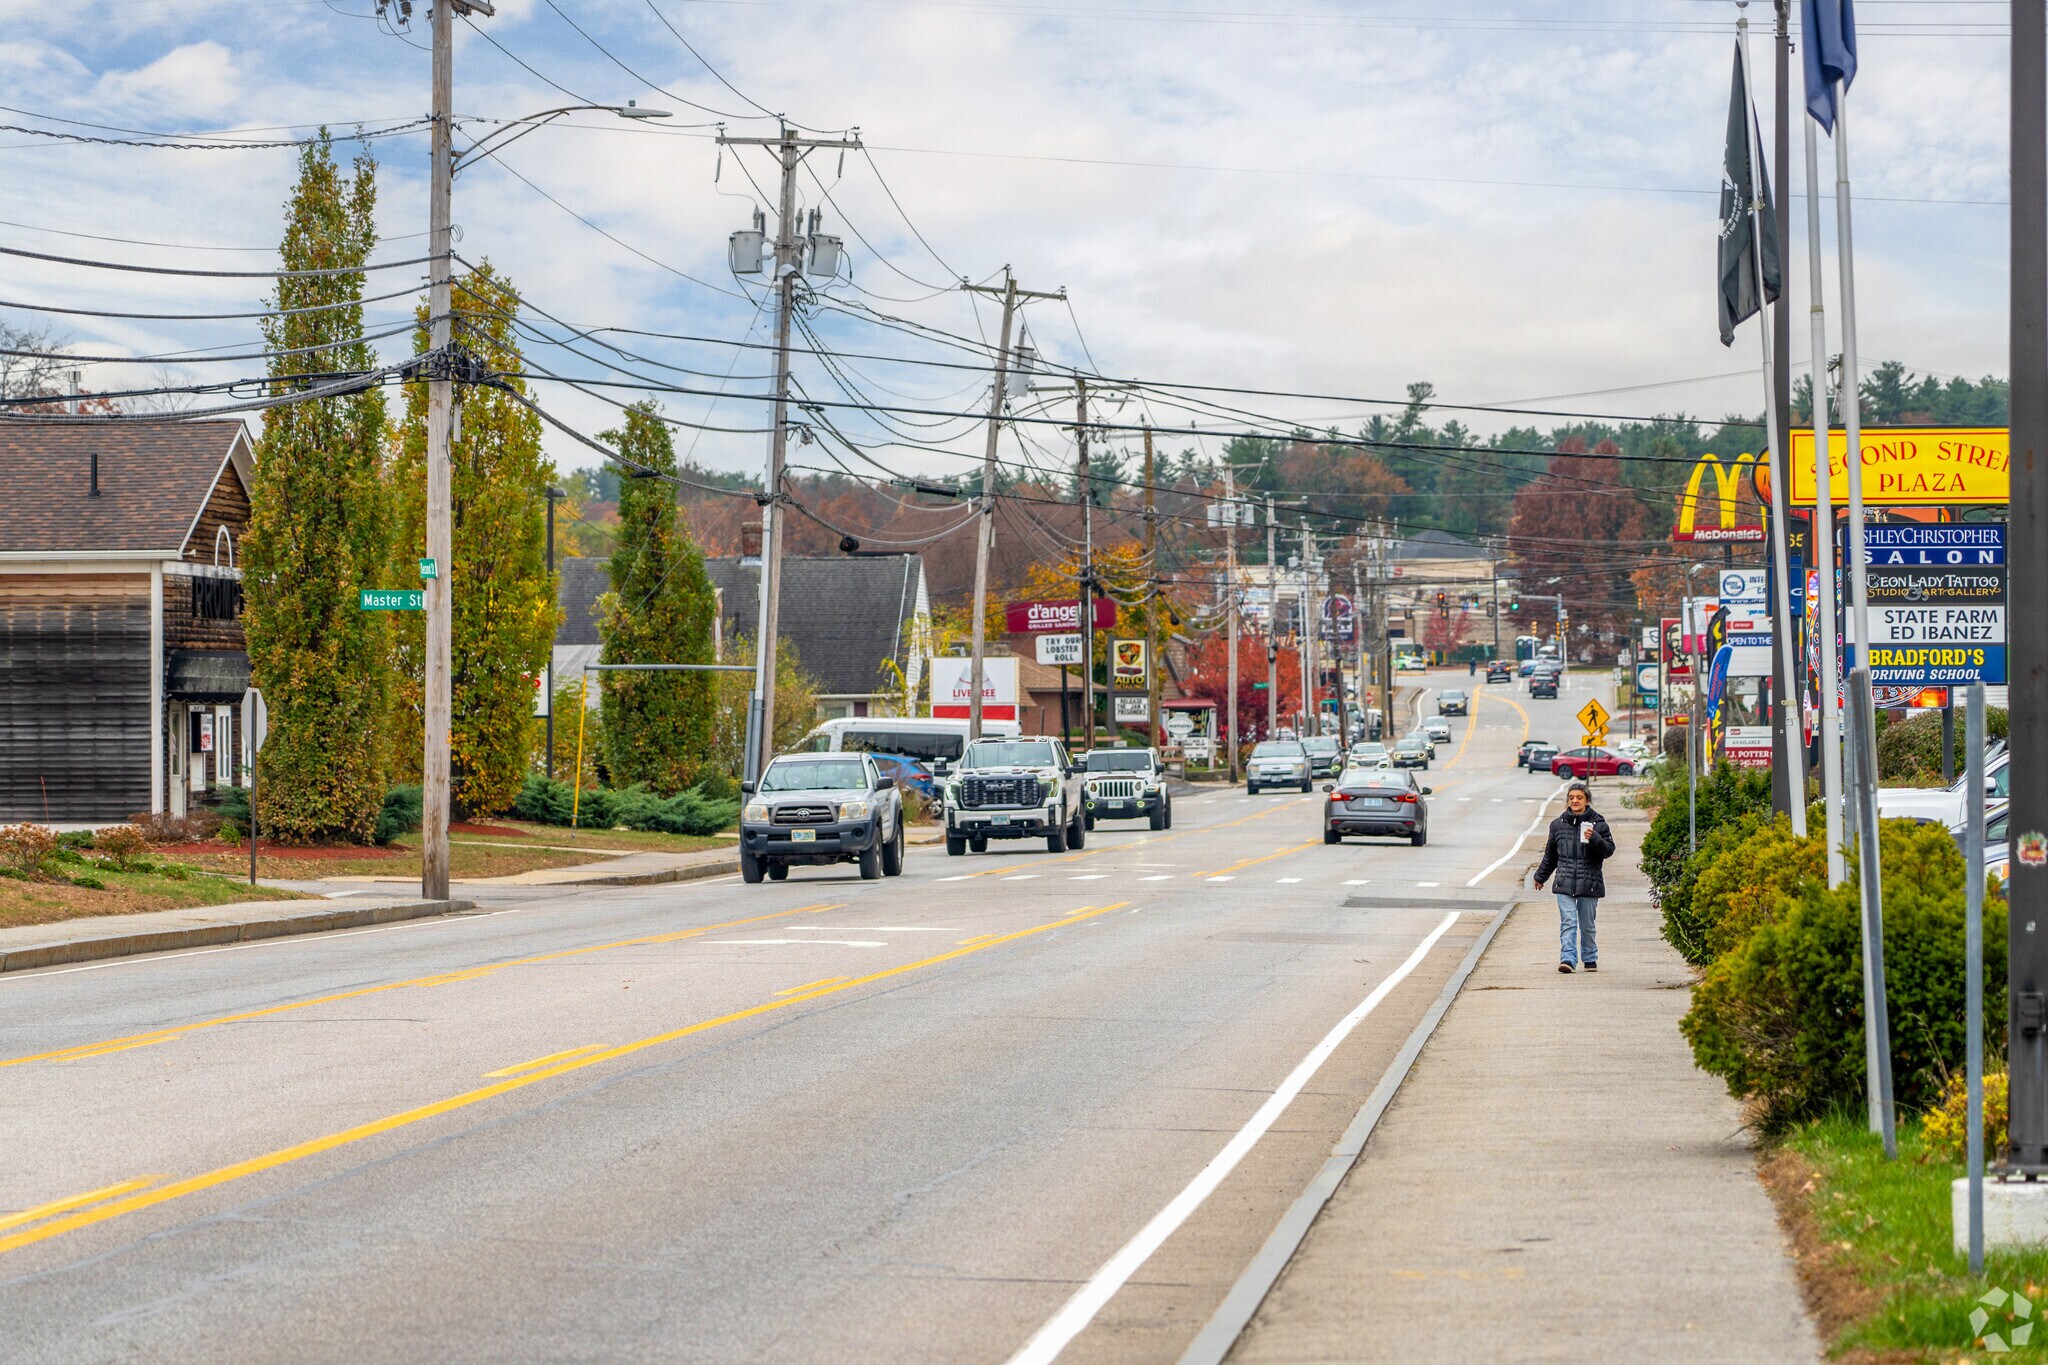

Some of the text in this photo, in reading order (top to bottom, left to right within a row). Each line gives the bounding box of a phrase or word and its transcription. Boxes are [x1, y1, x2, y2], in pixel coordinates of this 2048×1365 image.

[1936, 441, 2010, 474] STRE
[1878, 473, 1966, 492] PLAZA
[1694, 530, 1762, 540] McDonald's
[1864, 527, 2001, 544] SHLEYCHRISTOPHER
[1864, 550, 1994, 564] SALON
[192, 576, 245, 620] PROMP
[1866, 588, 1909, 598] STUDIO
[1944, 587, 2001, 596] GALLERY
[364, 594, 421, 606] Master St
[1028, 601, 1082, 621] d'angel
[1884, 610, 1998, 624] STATE FARM
[1890, 626, 1993, 640] ED IBANEZ
[1065, 636, 1081, 644] OUR
[1727, 636, 1772, 645] OPEN TO THE
[1046, 645, 1079, 654] LOBSTER
[1868, 649, 1985, 667] BRADFORD'S
[1115, 676, 1145, 685] AUTO
[1870, 669, 1981, 680] DRIVING SCHOOL
[981, 688, 996, 697] REE
[1738, 750, 1770, 758] POTTER
